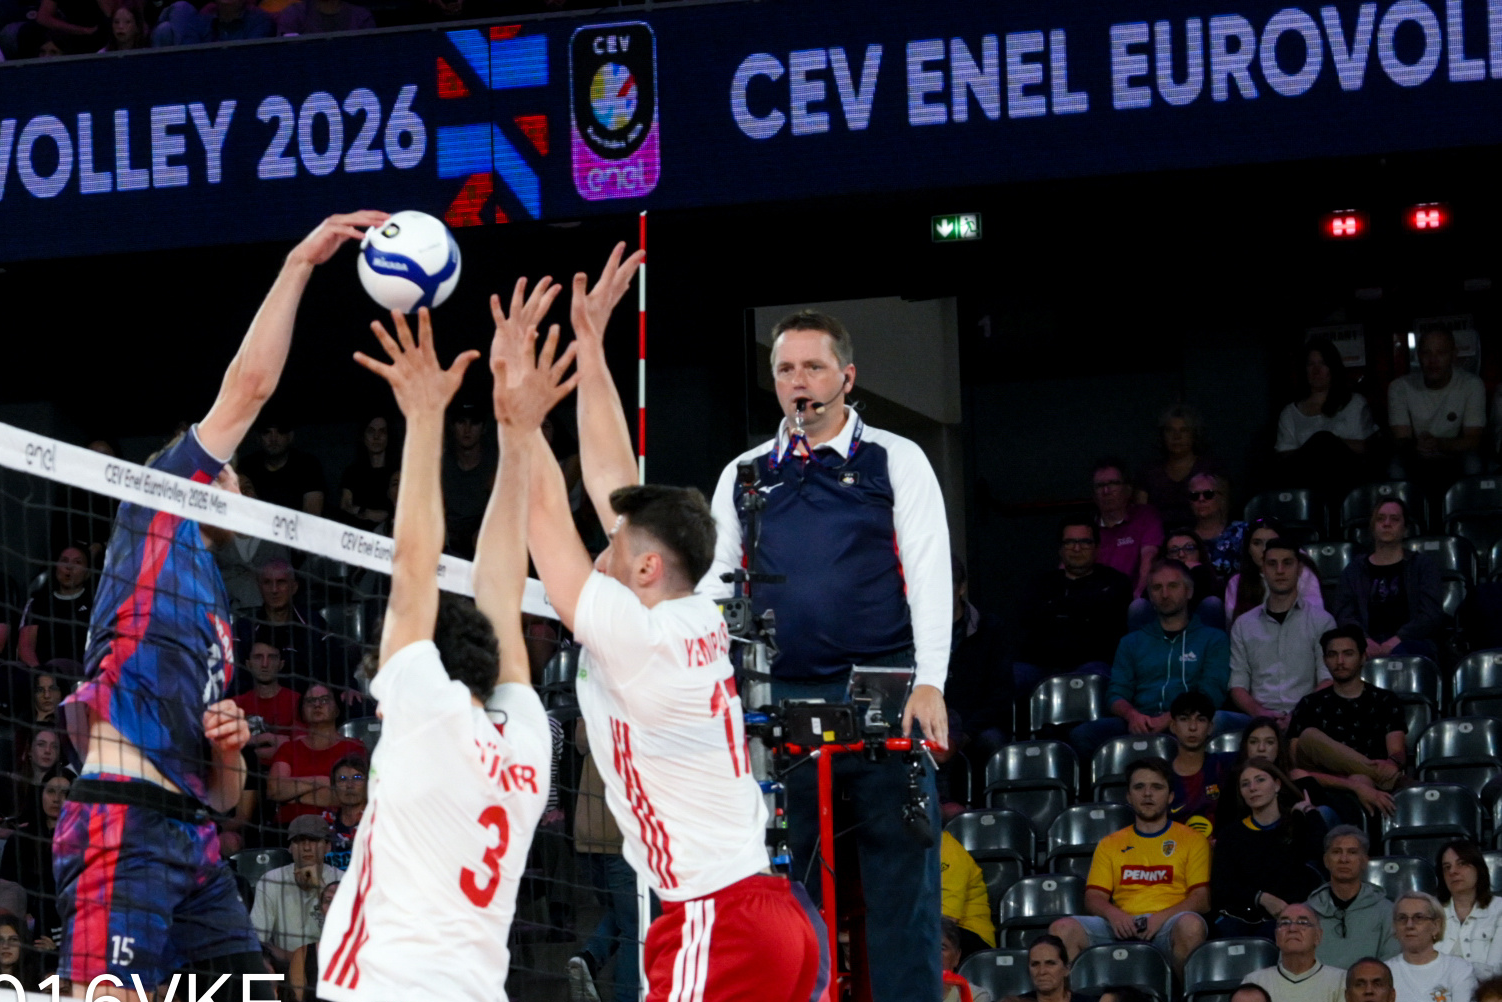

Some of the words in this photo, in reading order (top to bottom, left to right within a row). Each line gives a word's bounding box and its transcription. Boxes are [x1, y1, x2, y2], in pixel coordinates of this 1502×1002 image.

[592, 34, 631, 55] CEV
[731, 44, 883, 139] CEV
[907, 28, 1089, 126] ENEL
[256, 85, 428, 180] 2026
[25, 441, 57, 473] enel
[105, 462, 125, 486] CEV
[125, 468, 144, 491] Enel
[145, 474, 187, 508] EuroVolley
[209, 492, 228, 515] Men
[272, 513, 299, 541] enel
[340, 530, 357, 552] CEV
[358, 535, 374, 555] Enel
[459, 804, 510, 907] 3
[1122, 869, 1168, 882] PENNY.
[111, 934, 136, 967] 15
